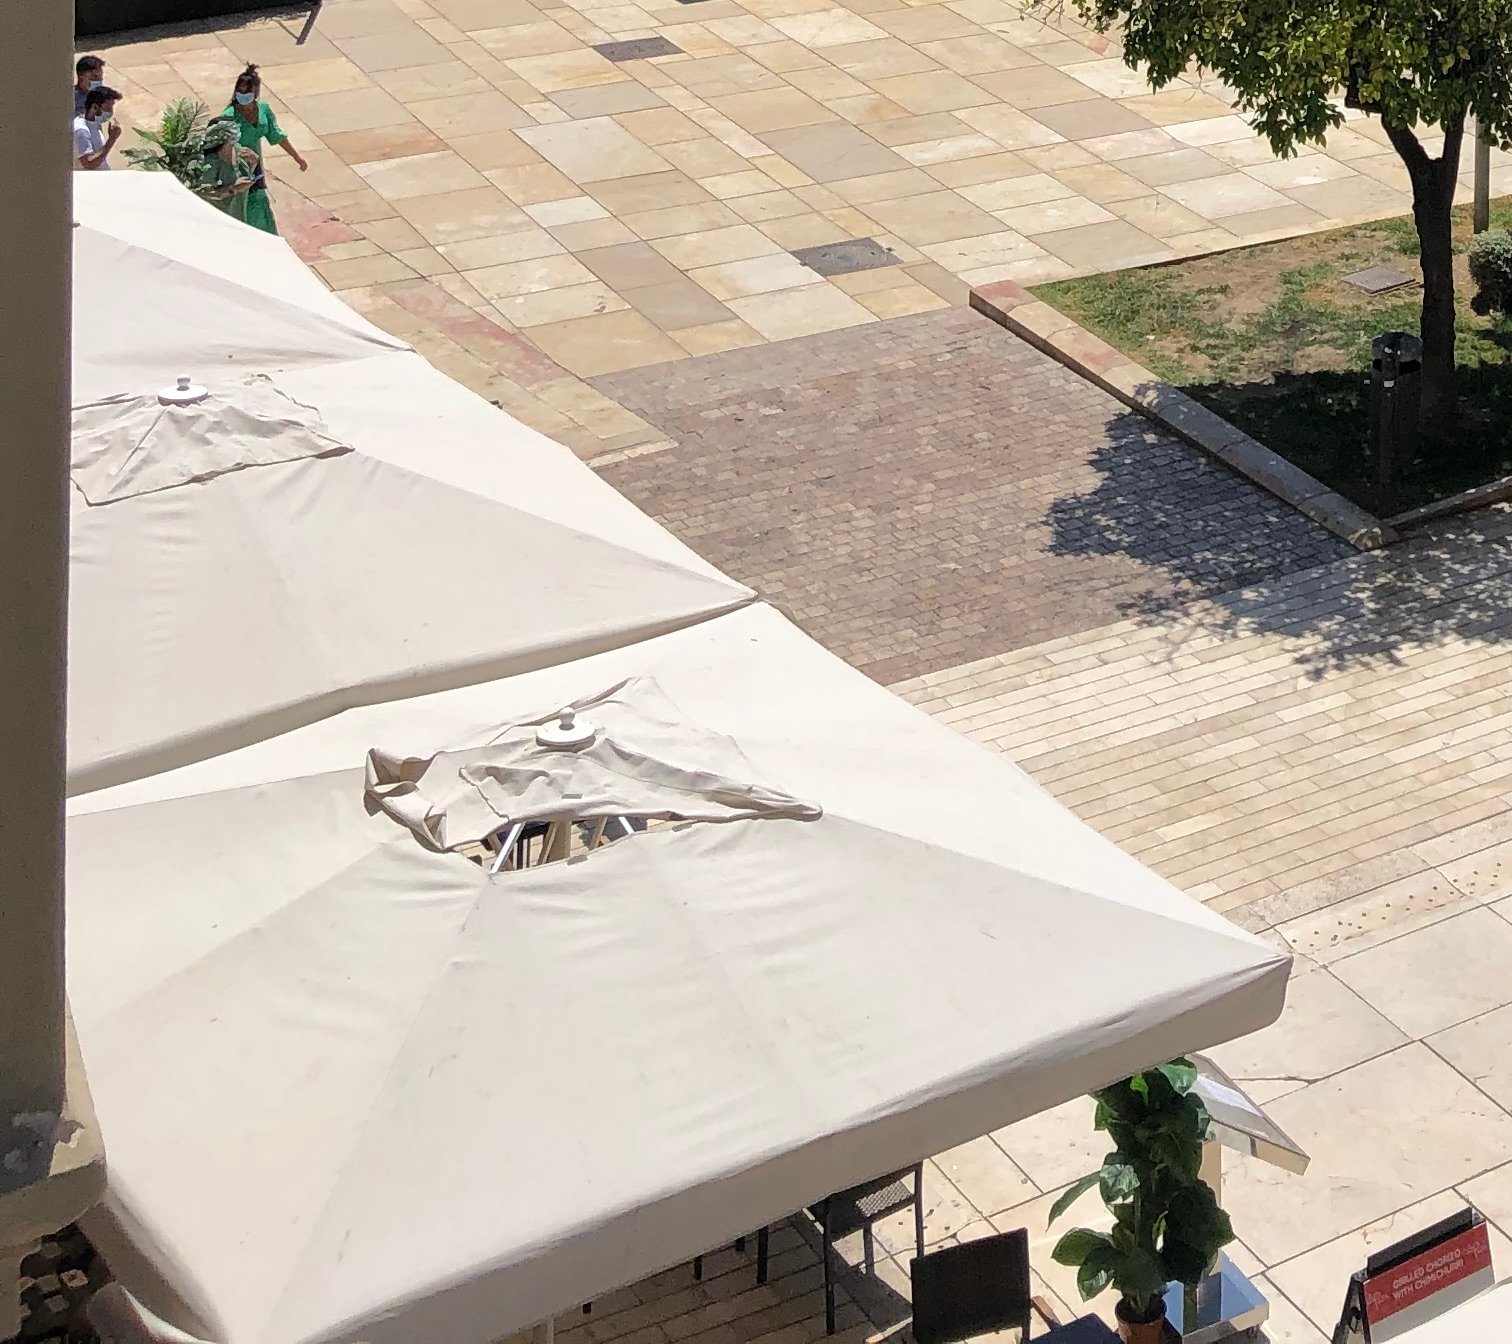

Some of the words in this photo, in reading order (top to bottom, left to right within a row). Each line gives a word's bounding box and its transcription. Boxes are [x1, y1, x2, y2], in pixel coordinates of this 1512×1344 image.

[1392, 1266, 1425, 1289] GRILLED
[1426, 1248, 1461, 1271] CHORIZO
[1392, 1284, 1414, 1300] WITH
